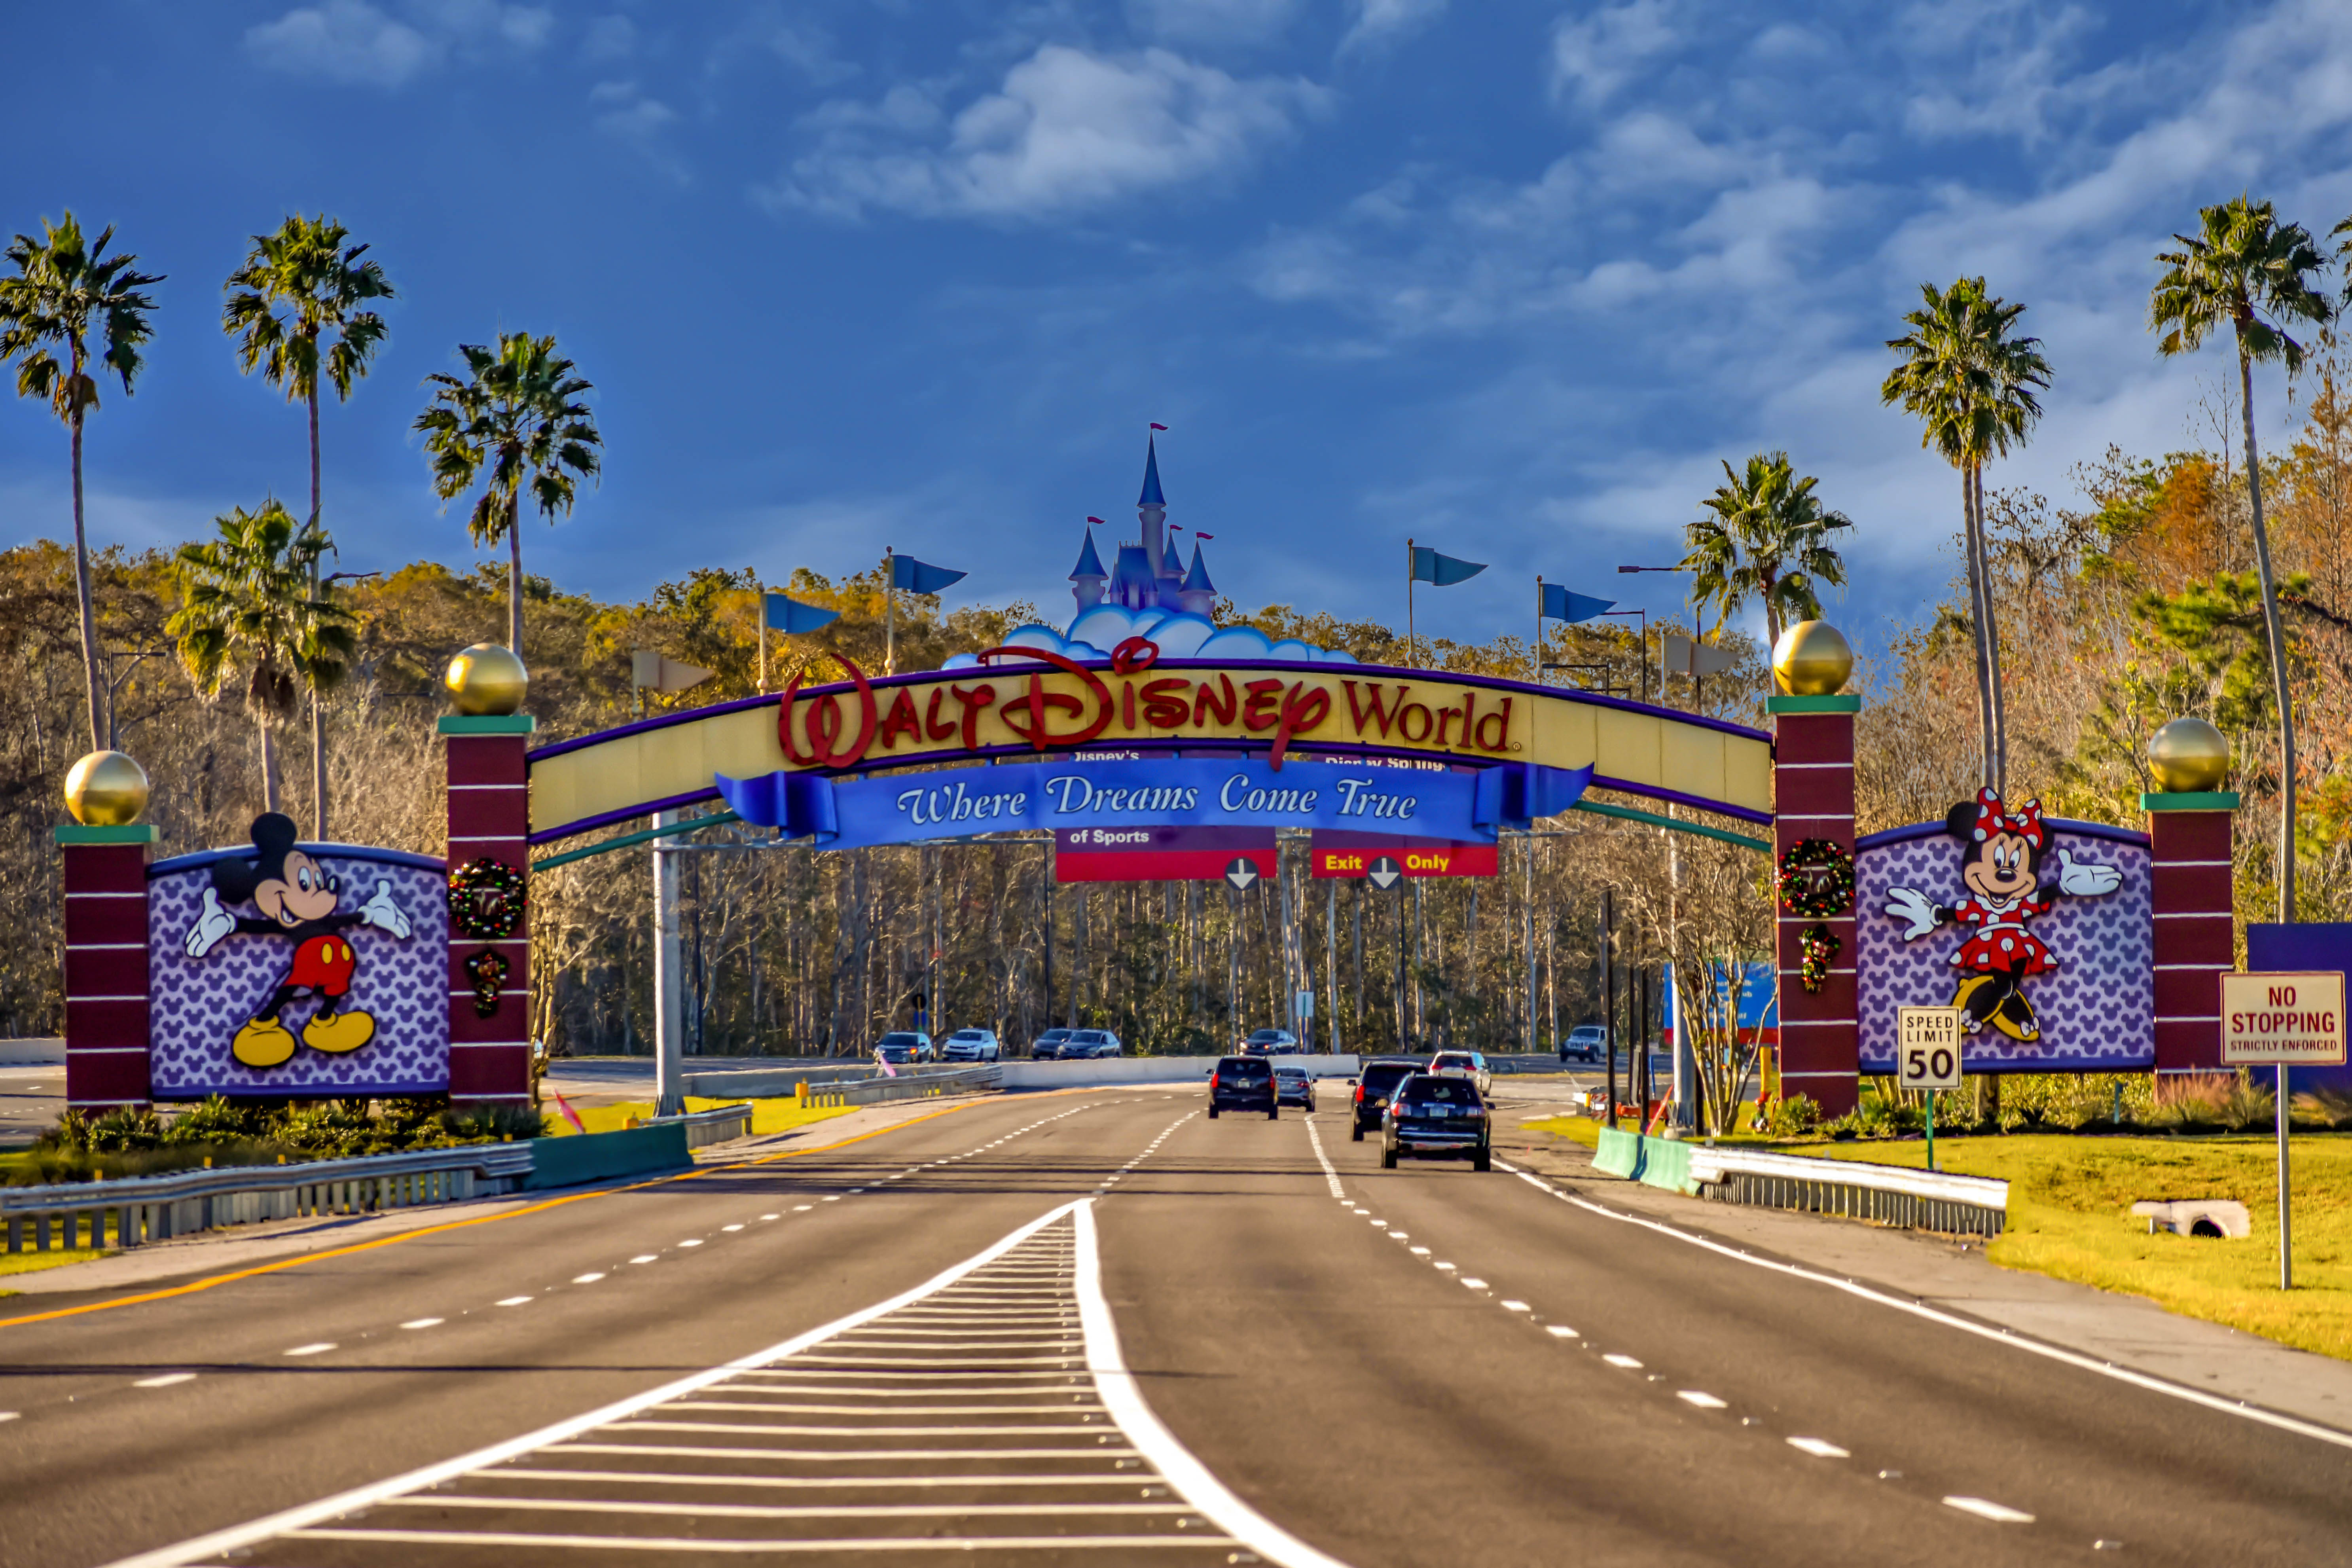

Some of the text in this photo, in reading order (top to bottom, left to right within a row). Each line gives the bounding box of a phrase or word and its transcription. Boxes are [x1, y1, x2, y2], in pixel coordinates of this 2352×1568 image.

[1342, 680, 1513, 751] World
[898, 774, 1417, 825] Where Dreams Come True
[1070, 829, 1149, 845] of Sports
[1326, 855, 1449, 872] Exit Only
[2269, 986, 2296, 1007] NO
[1907, 1016, 1953, 1028] SPEED
[2232, 1012, 2335, 1033] STOPPING
[1907, 1030, 1952, 1043] LIMIT
[2231, 1039, 2337, 1052] STRICTLY ENFORCED
[1907, 1049, 1954, 1080] 50
